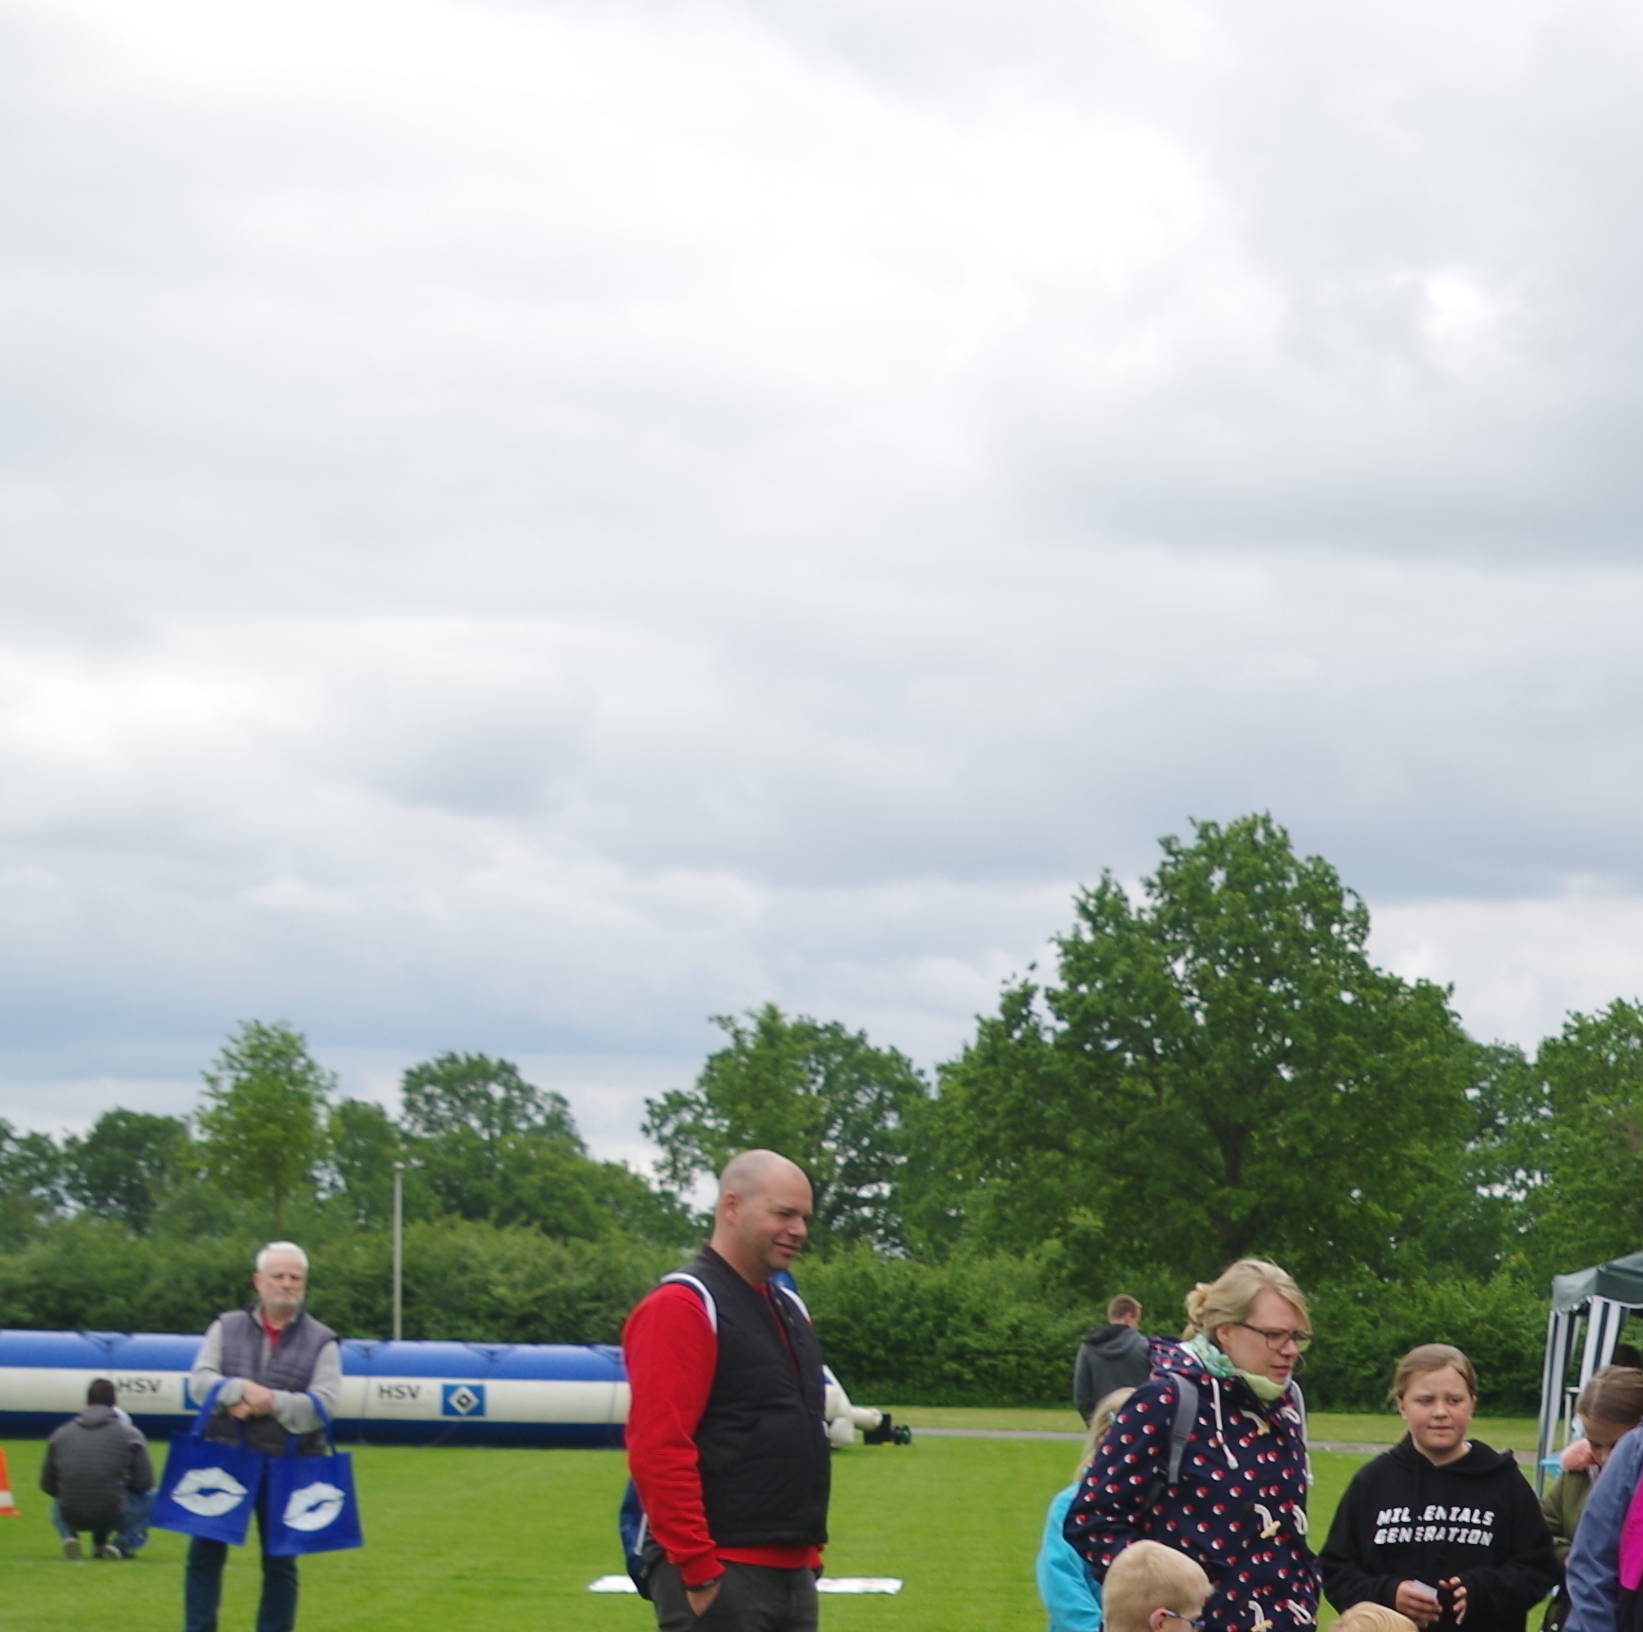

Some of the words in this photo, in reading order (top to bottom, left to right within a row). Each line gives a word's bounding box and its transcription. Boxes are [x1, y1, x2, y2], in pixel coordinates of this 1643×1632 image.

[116, 1377, 162, 1394] HSV
[379, 1383, 421, 1400] HSV
[1376, 1504, 1495, 1526] MILENIALS
[1373, 1525, 1494, 1547] GENERATION
